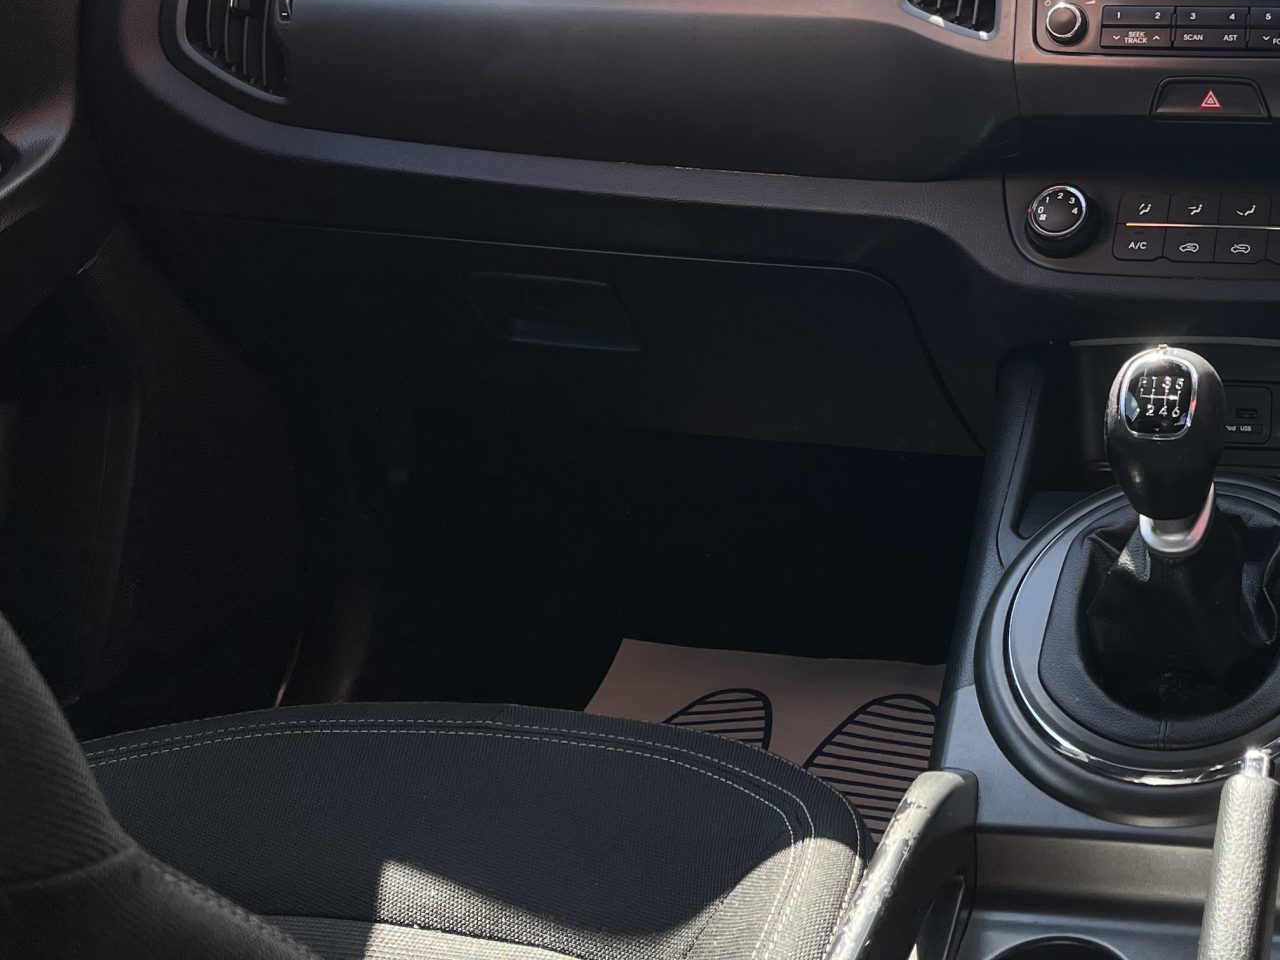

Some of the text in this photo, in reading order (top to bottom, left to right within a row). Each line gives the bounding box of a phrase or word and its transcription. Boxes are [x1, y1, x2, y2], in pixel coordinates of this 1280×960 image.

[1162, 376, 1172, 390] 3
[1176, 378, 1184, 390] 5
[1146, 404, 1155, 416] 2
[1158, 406, 1168, 417] 4
[1172, 406, 1180, 418] 6
